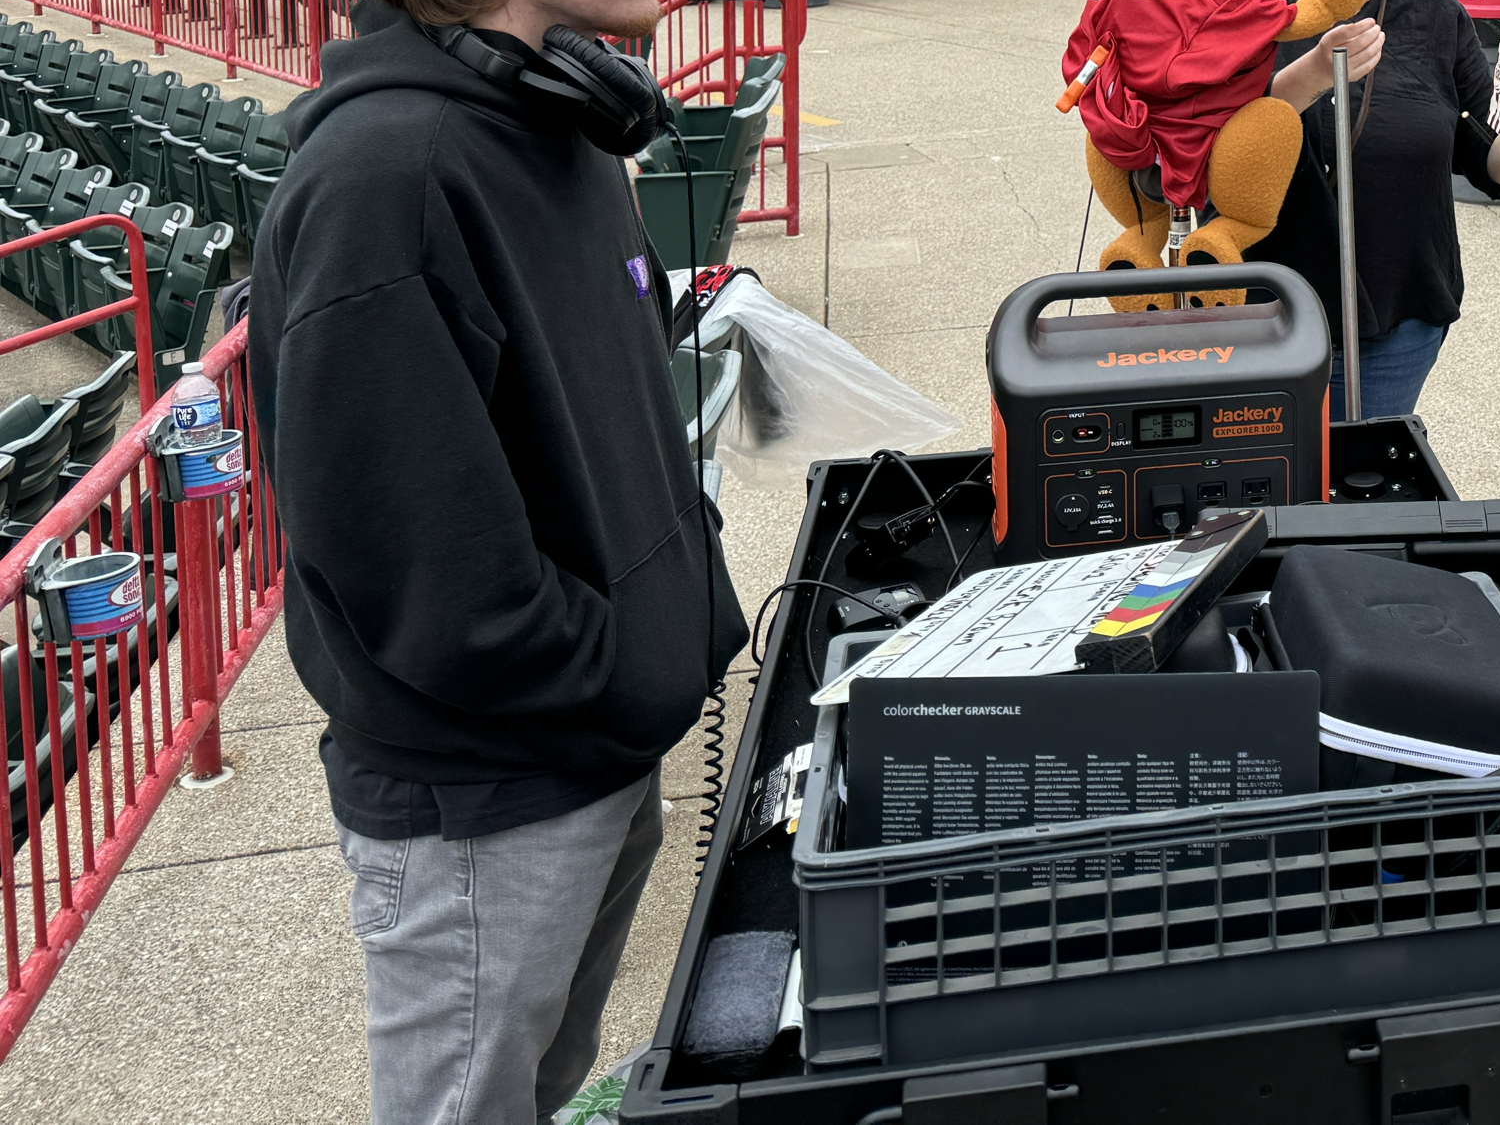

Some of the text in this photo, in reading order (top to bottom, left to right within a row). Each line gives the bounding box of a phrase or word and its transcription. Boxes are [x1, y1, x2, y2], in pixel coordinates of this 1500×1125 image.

[1096, 346, 1235, 369] Jackery
[176, 407, 193, 416] Pure
[1212, 407, 1283, 424] Jackery
[178, 414, 192, 423] Life
[1215, 425, 1281, 437] EXPLORER 1000
[953, 613, 1018, 647] Brown
[883, 704, 1021, 716] colorchecker GRAYSCALE
